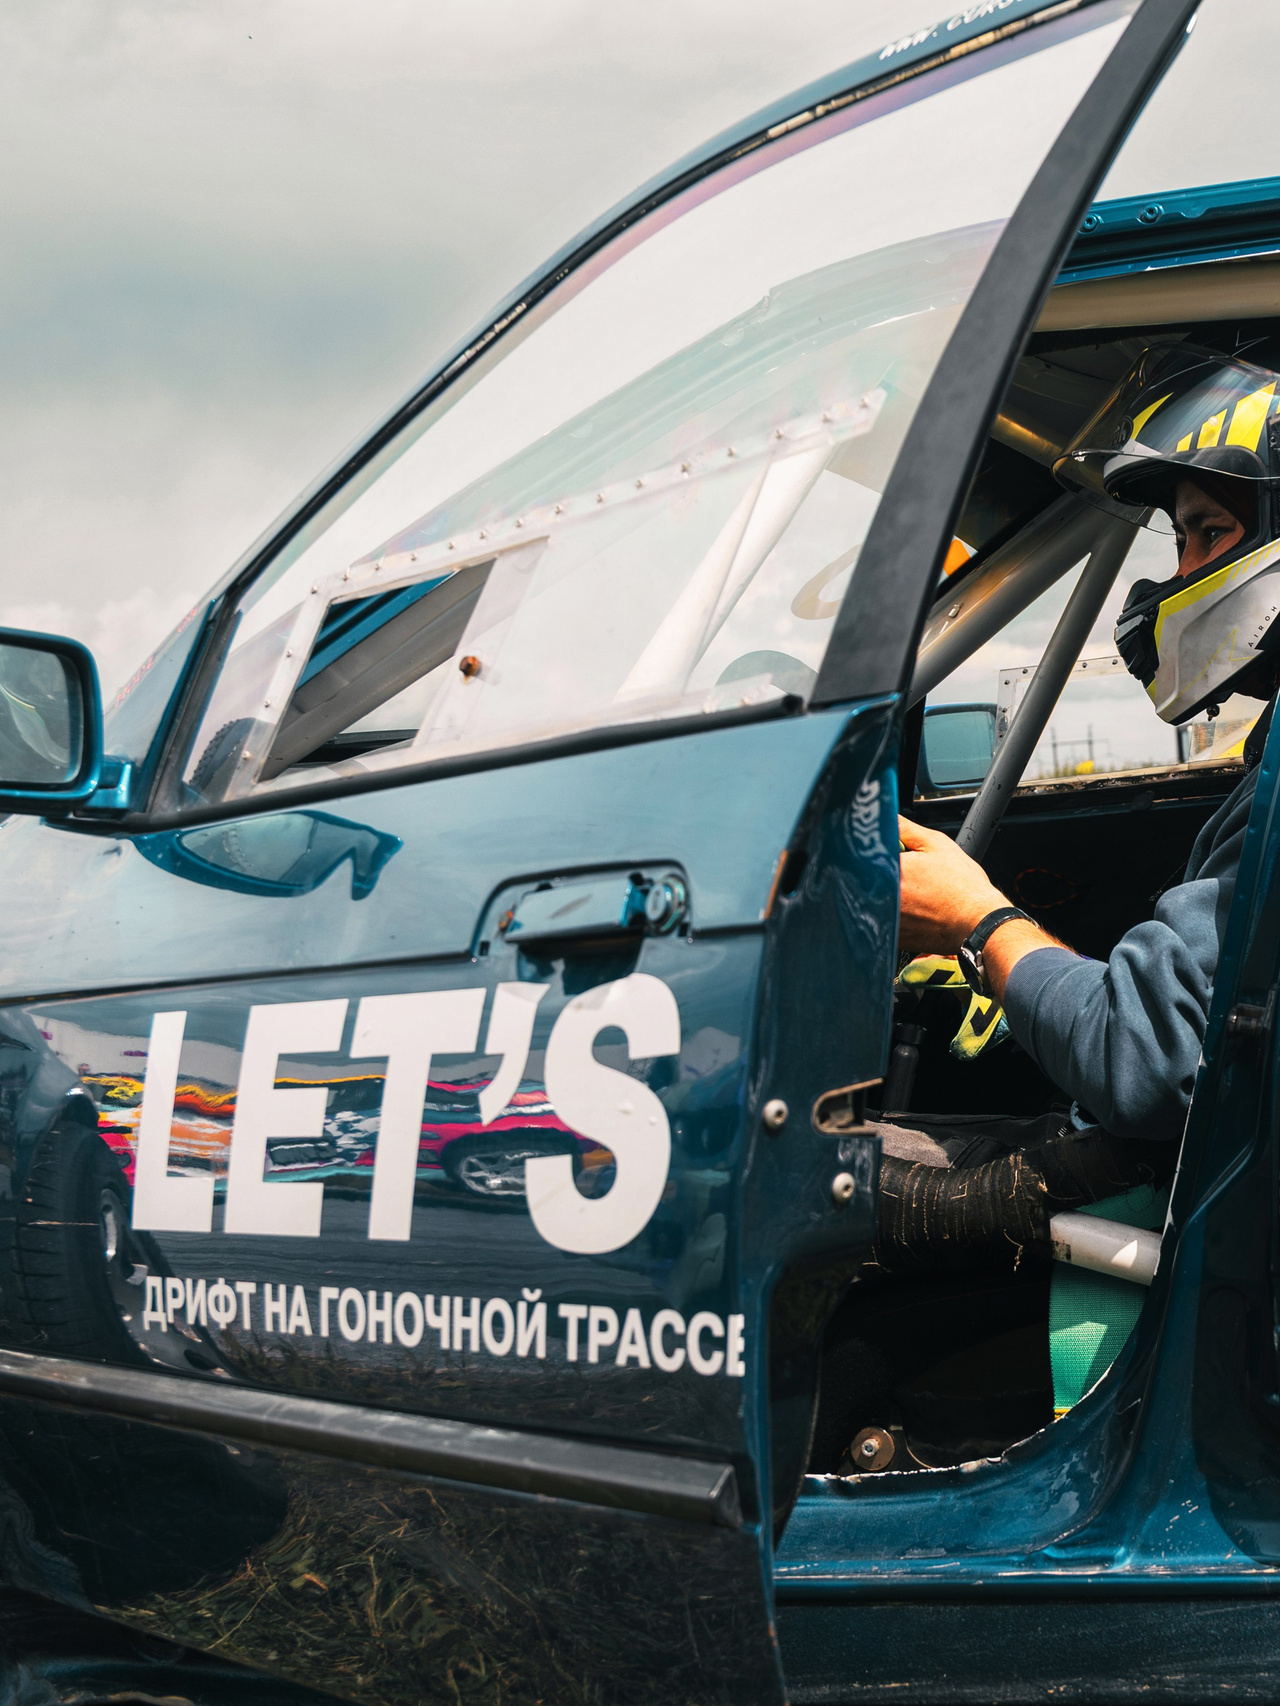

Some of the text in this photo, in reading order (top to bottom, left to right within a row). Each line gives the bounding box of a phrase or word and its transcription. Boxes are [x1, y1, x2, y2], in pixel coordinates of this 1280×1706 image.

[1248, 606, 1277, 648] AIROH
[131, 972, 681, 1254] LET'S
[142, 1275, 257, 1333] ДРИФТ
[264, 1282, 313, 1337] НА
[320, 1286, 547, 1359] ГОНОЧНОЙ
